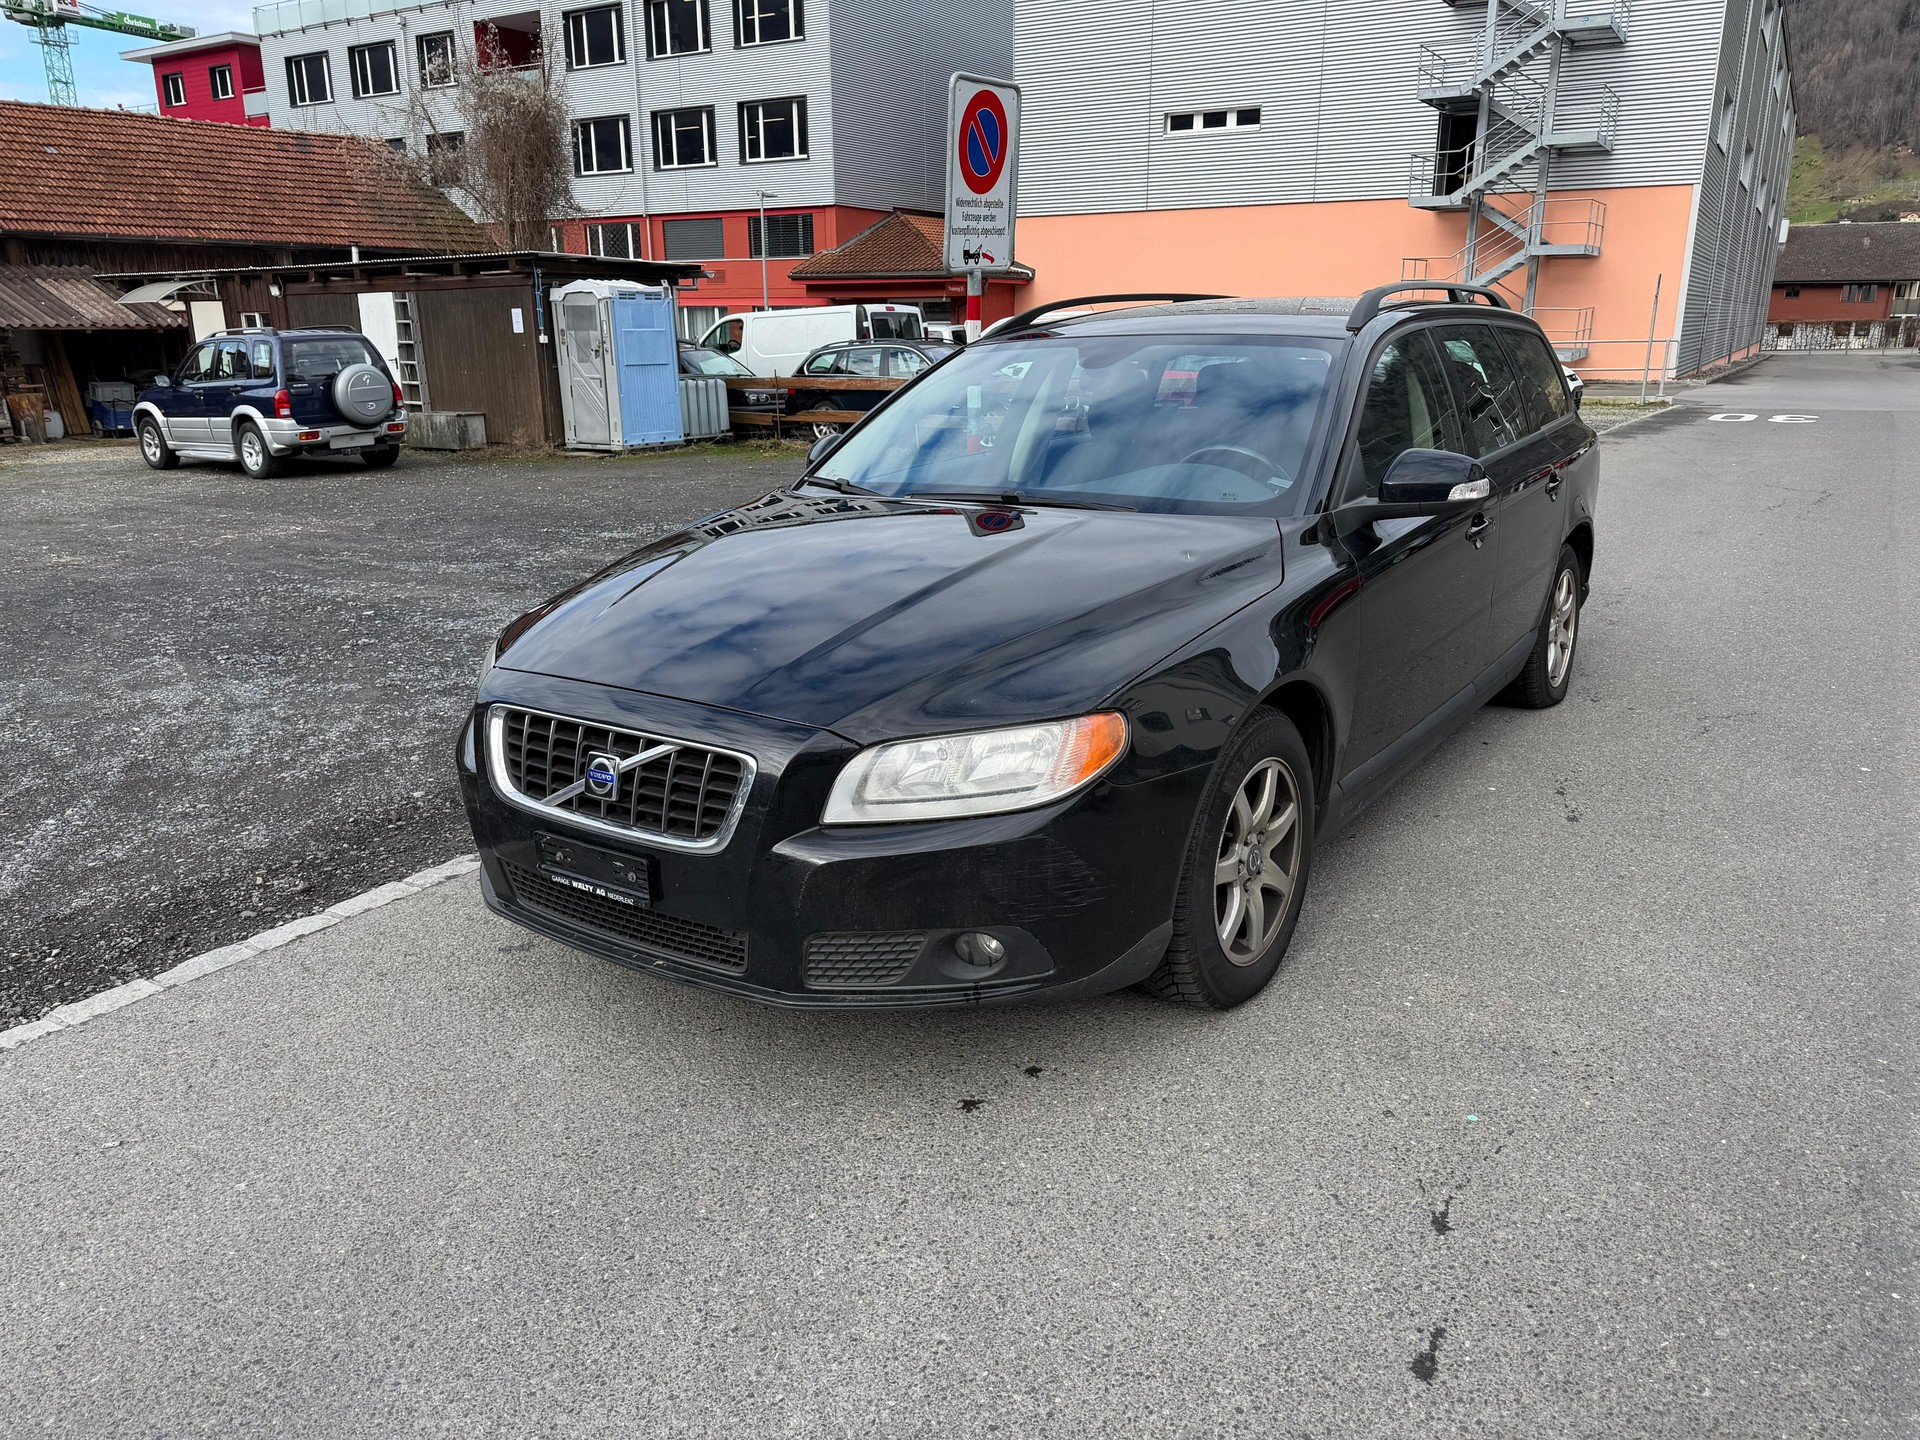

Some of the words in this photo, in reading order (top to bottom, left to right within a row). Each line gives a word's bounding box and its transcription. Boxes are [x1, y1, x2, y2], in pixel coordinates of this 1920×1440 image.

[955, 196, 982, 208] Widerrechtlich
[983, 197, 1004, 211] abgestellte
[961, 211, 982, 224] Fahrzeuge
[982, 211, 997, 222] werden
[951, 224, 980, 238] kostenpflichtig
[1707, 413, 1820, 423] 30
[590, 771, 612, 781] VOLVO
[595, 888, 606, 897] AG
